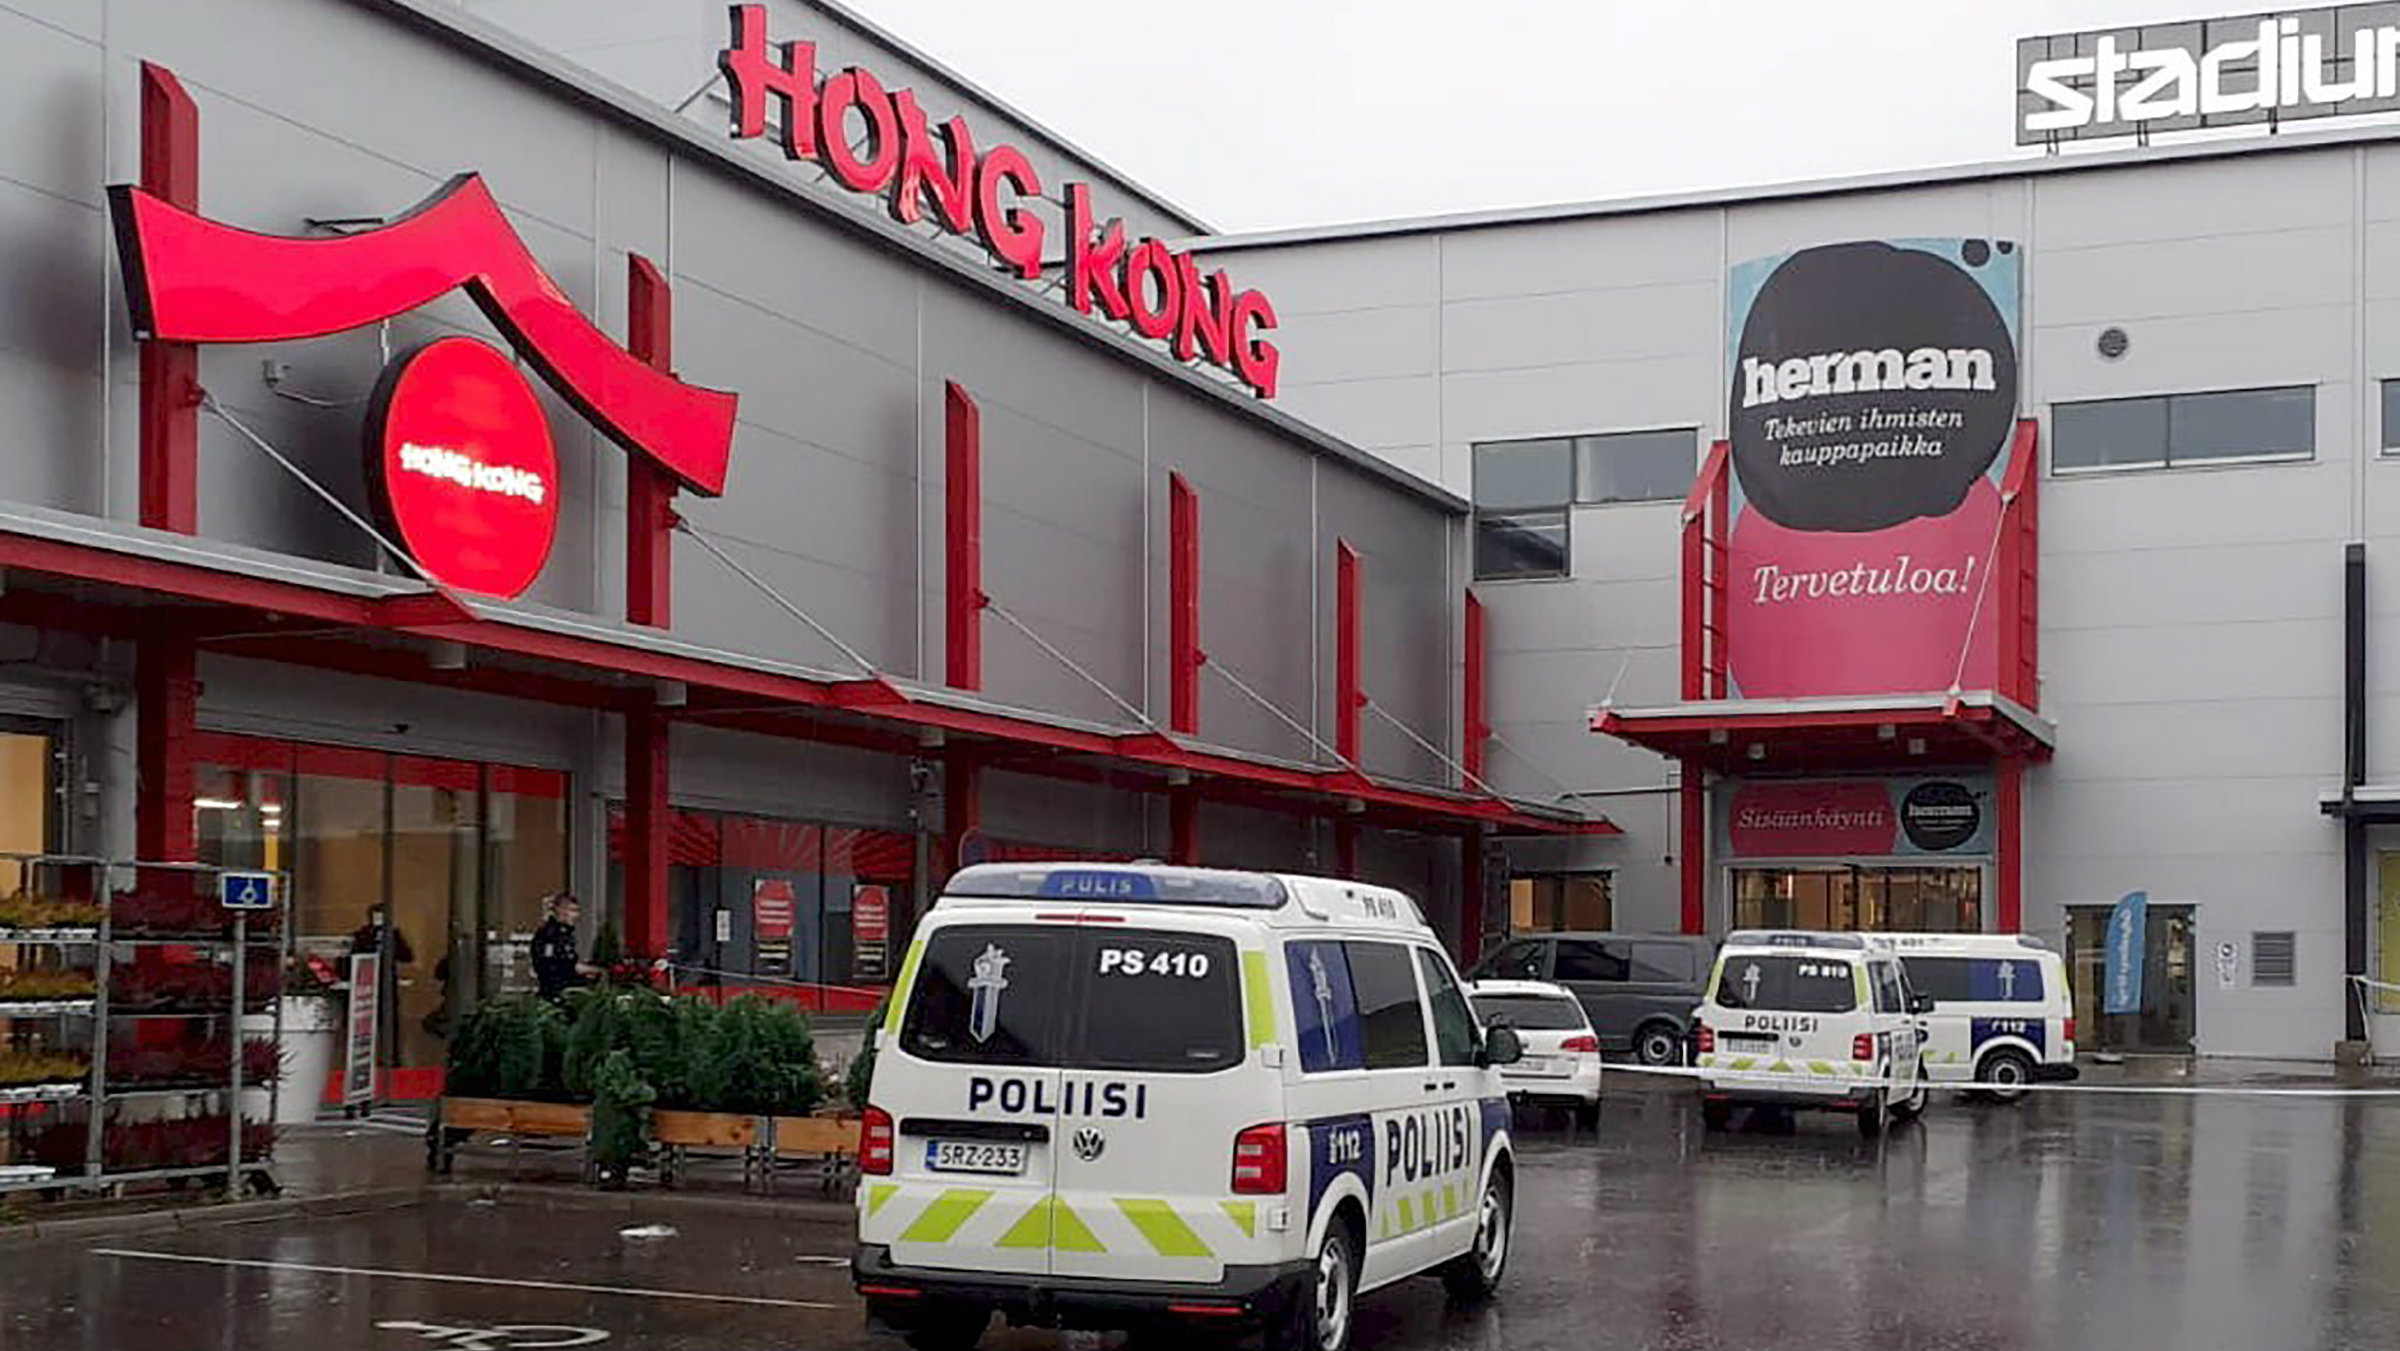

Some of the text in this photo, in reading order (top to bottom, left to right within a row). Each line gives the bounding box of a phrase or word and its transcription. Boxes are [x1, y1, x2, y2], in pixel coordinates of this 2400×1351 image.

[719, 3, 1279, 399] HONG KONG
[1742, 347, 1996, 408] herman
[1763, 406, 1963, 441] Tekevien ihmisten
[1779, 434, 1943, 467] kauppapaikka
[399, 442, 545, 505] HONG KONG
[1753, 556, 1975, 603] Tervetuloa!
[1099, 949, 1209, 978] PS 410
[1745, 1014, 1818, 1033] POLIISI
[968, 1077, 1146, 1119] POLIISI
[940, 1145, 1021, 1168] SRZ-233
[1338, 1129, 1361, 1163] 112
[1386, 1104, 1471, 1187] POLIISI
